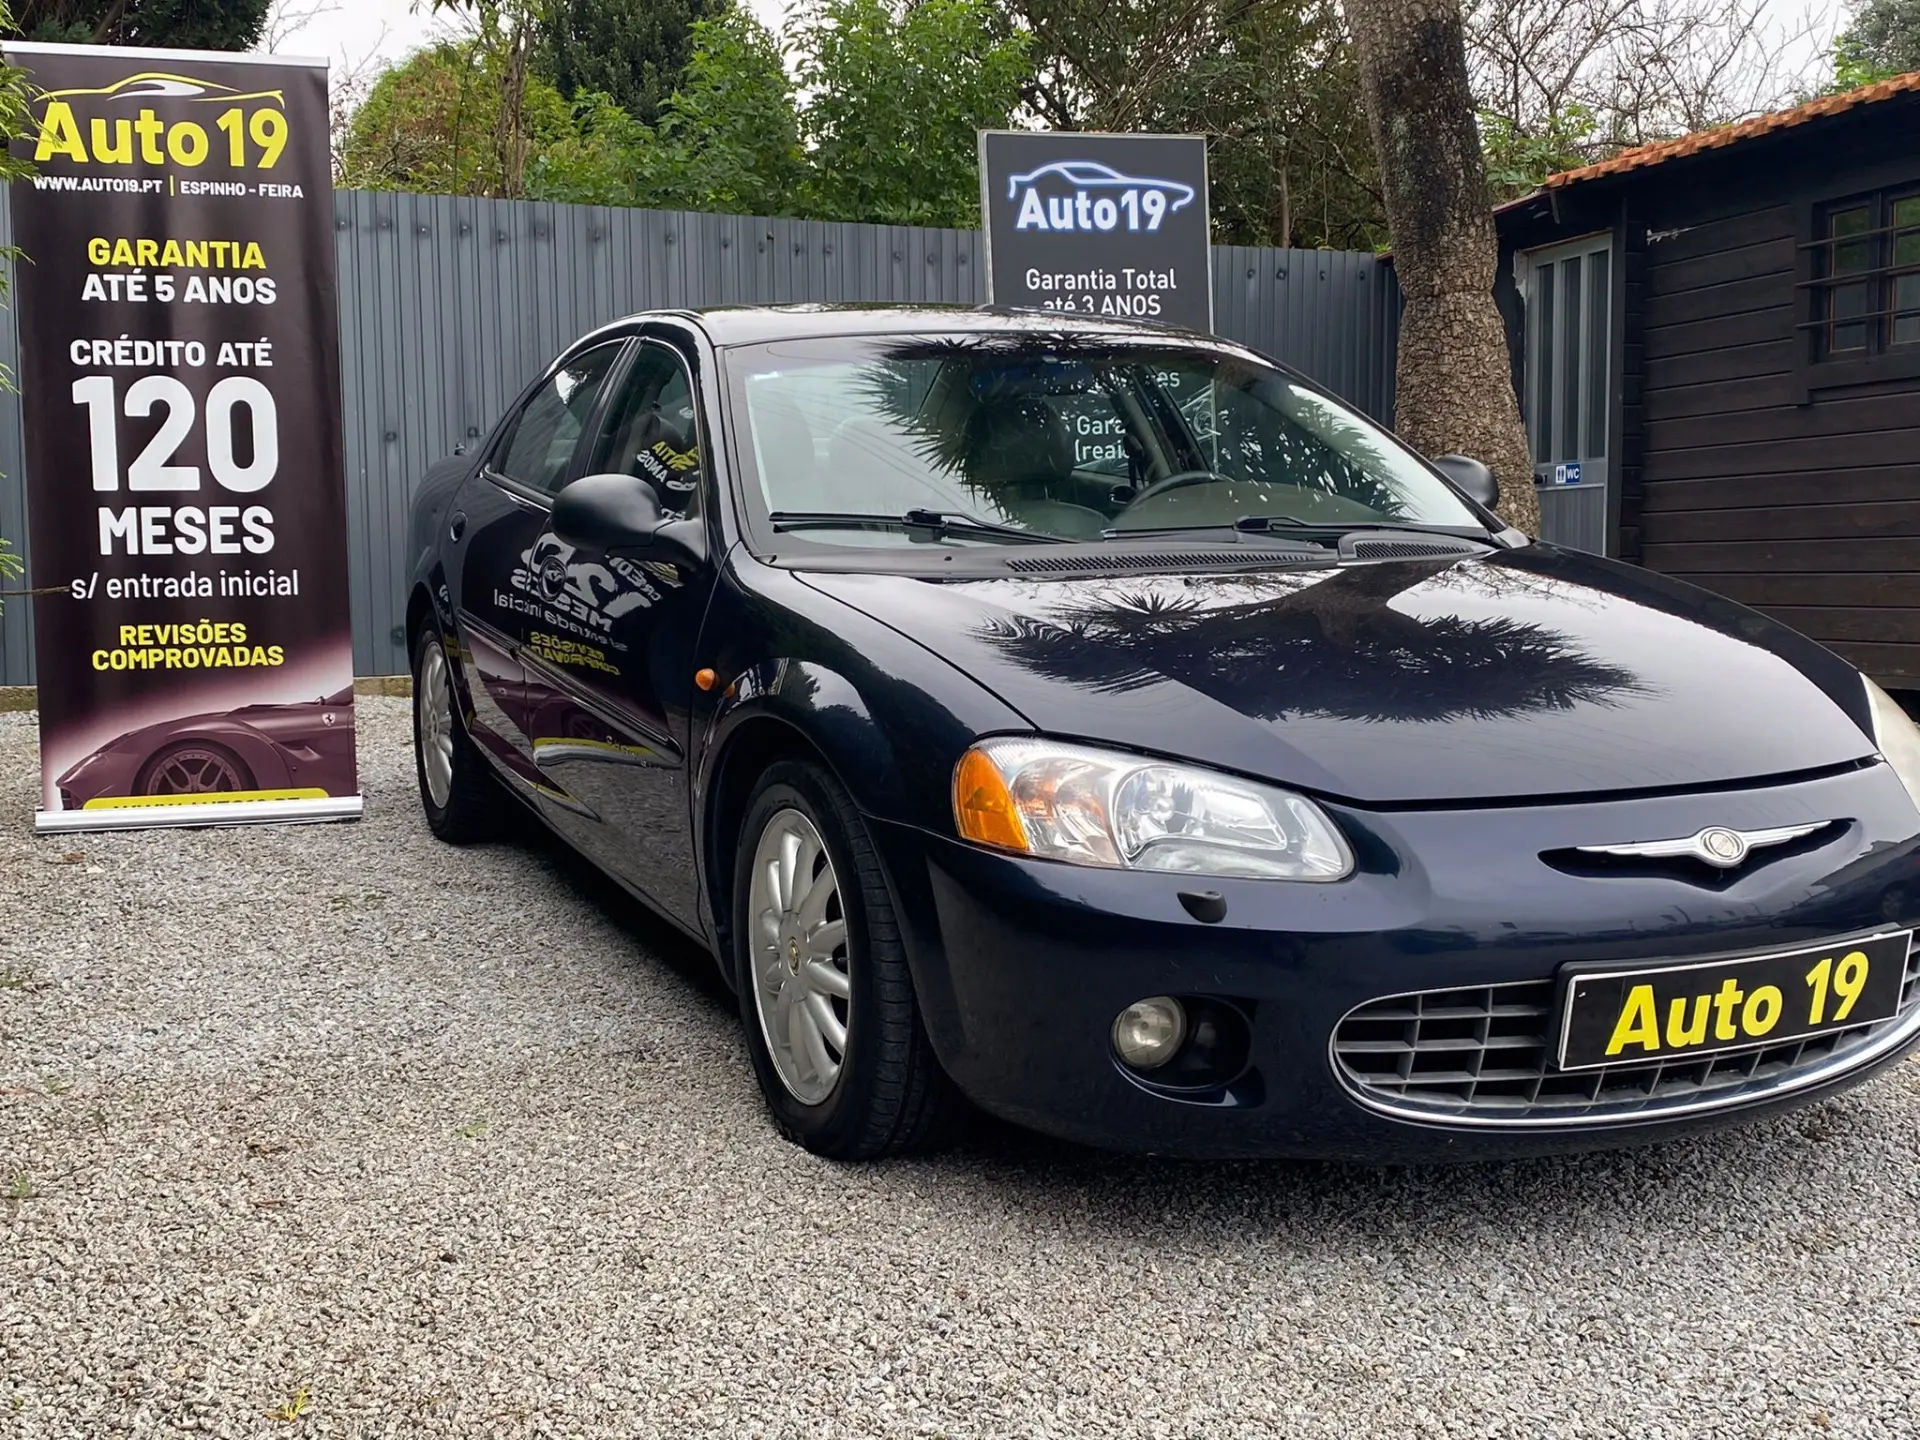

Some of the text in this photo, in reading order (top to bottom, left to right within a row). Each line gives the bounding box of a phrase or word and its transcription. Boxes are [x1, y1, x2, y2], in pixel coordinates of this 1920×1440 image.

[32, 102, 288, 168] Auto 19
[33, 175, 162, 193] WWW.AUTO19.PT
[181, 181, 246, 196] ESPINHO
[259, 184, 303, 198] FEIRA
[88, 238, 266, 269] GARANTIA
[82, 268, 276, 304] ATÉ 5 ANOS
[1026, 269, 1176, 290] Garantia Total
[1082, 295, 1094, 312] 3
[1101, 295, 1161, 316] ANOS
[71, 334, 272, 366] CRÉDITO ATÉ
[72, 376, 278, 492] 120
[1077, 416, 1126, 435] Gara
[1566, 468, 1580, 480] WC
[99, 506, 274, 555] MESES
[72, 570, 298, 599] s/ entrada inicial
[120, 619, 246, 645] REVISÕES
[93, 645, 284, 670] COMPROVADAS
[1605, 952, 1868, 1055] Auto 19
